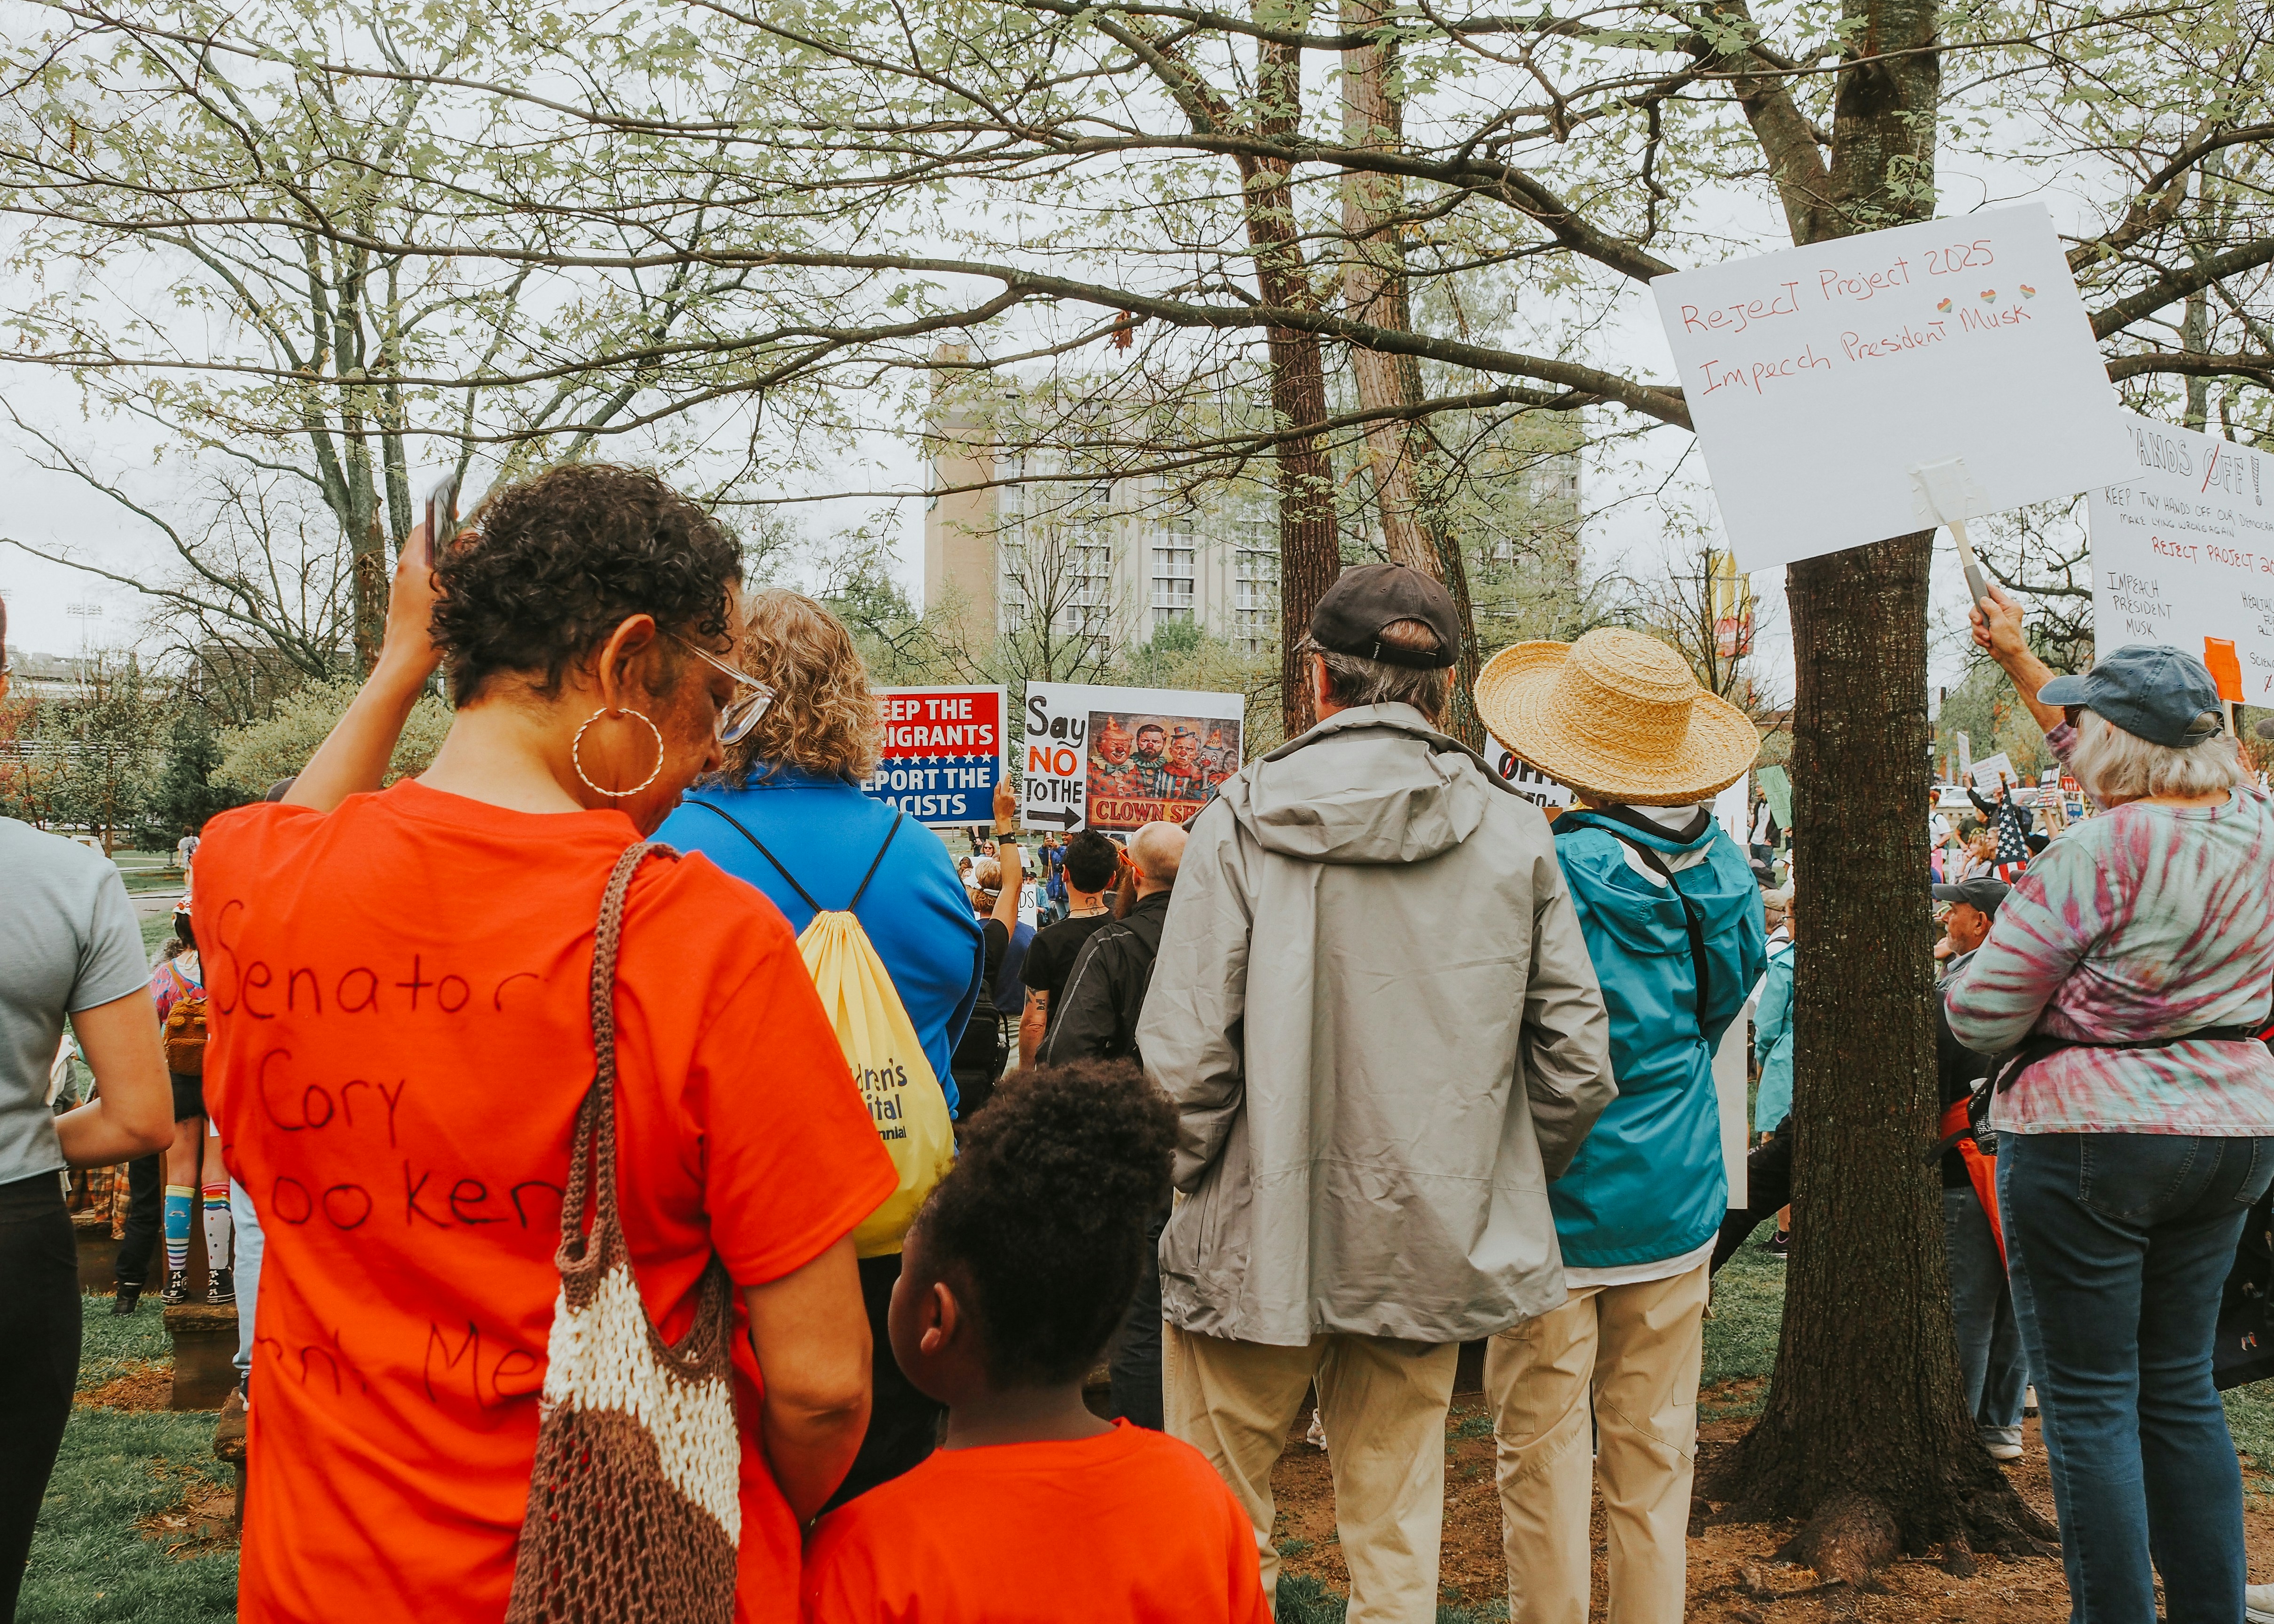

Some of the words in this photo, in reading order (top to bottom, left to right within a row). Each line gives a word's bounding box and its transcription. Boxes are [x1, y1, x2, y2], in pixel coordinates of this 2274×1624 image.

[1680, 281, 1801, 335] Reject
[1819, 256, 1909, 302] Project
[1923, 239, 1995, 277] 2025
[1840, 321, 1947, 363] President
[1959, 303, 2032, 334] Musk
[2126, 424, 2192, 476] ANDS
[2105, 486, 2131, 507] KEEP
[2163, 496, 2190, 515] HANDS
[2195, 506, 2211, 517] OFF
[2217, 509, 2235, 526] OUR
[2120, 513, 2146, 526] MAKE
[2151, 516, 2175, 529] LYING
[2178, 521, 2207, 533] WRONG
[2209, 525, 2234, 538] AGAIN
[2152, 536, 2197, 564] REJECT
[2206, 545, 2253, 573] PROJECT
[2107, 572, 2159, 600] IMPEACH
[2113, 595, 2172, 620] PRESIDENT
[2263, 614, 2274, 625] FO
[2126, 618, 2157, 640] MUSK
[925, 698, 973, 720] THE
[1026, 695, 1086, 749] Say
[881, 724, 994, 748] IGRANTS
[1028, 746, 1077, 776] NO
[942, 767, 991, 789] THE
[869, 793, 966, 816] ACISTS
[1096, 800, 1165, 823] CLOWN
[1169, 804, 1204, 823] SH
[848, 1058, 908, 1093] dren's
[260, 1048, 405, 1148] Cory
[221, 1143, 564, 1229] ooker
